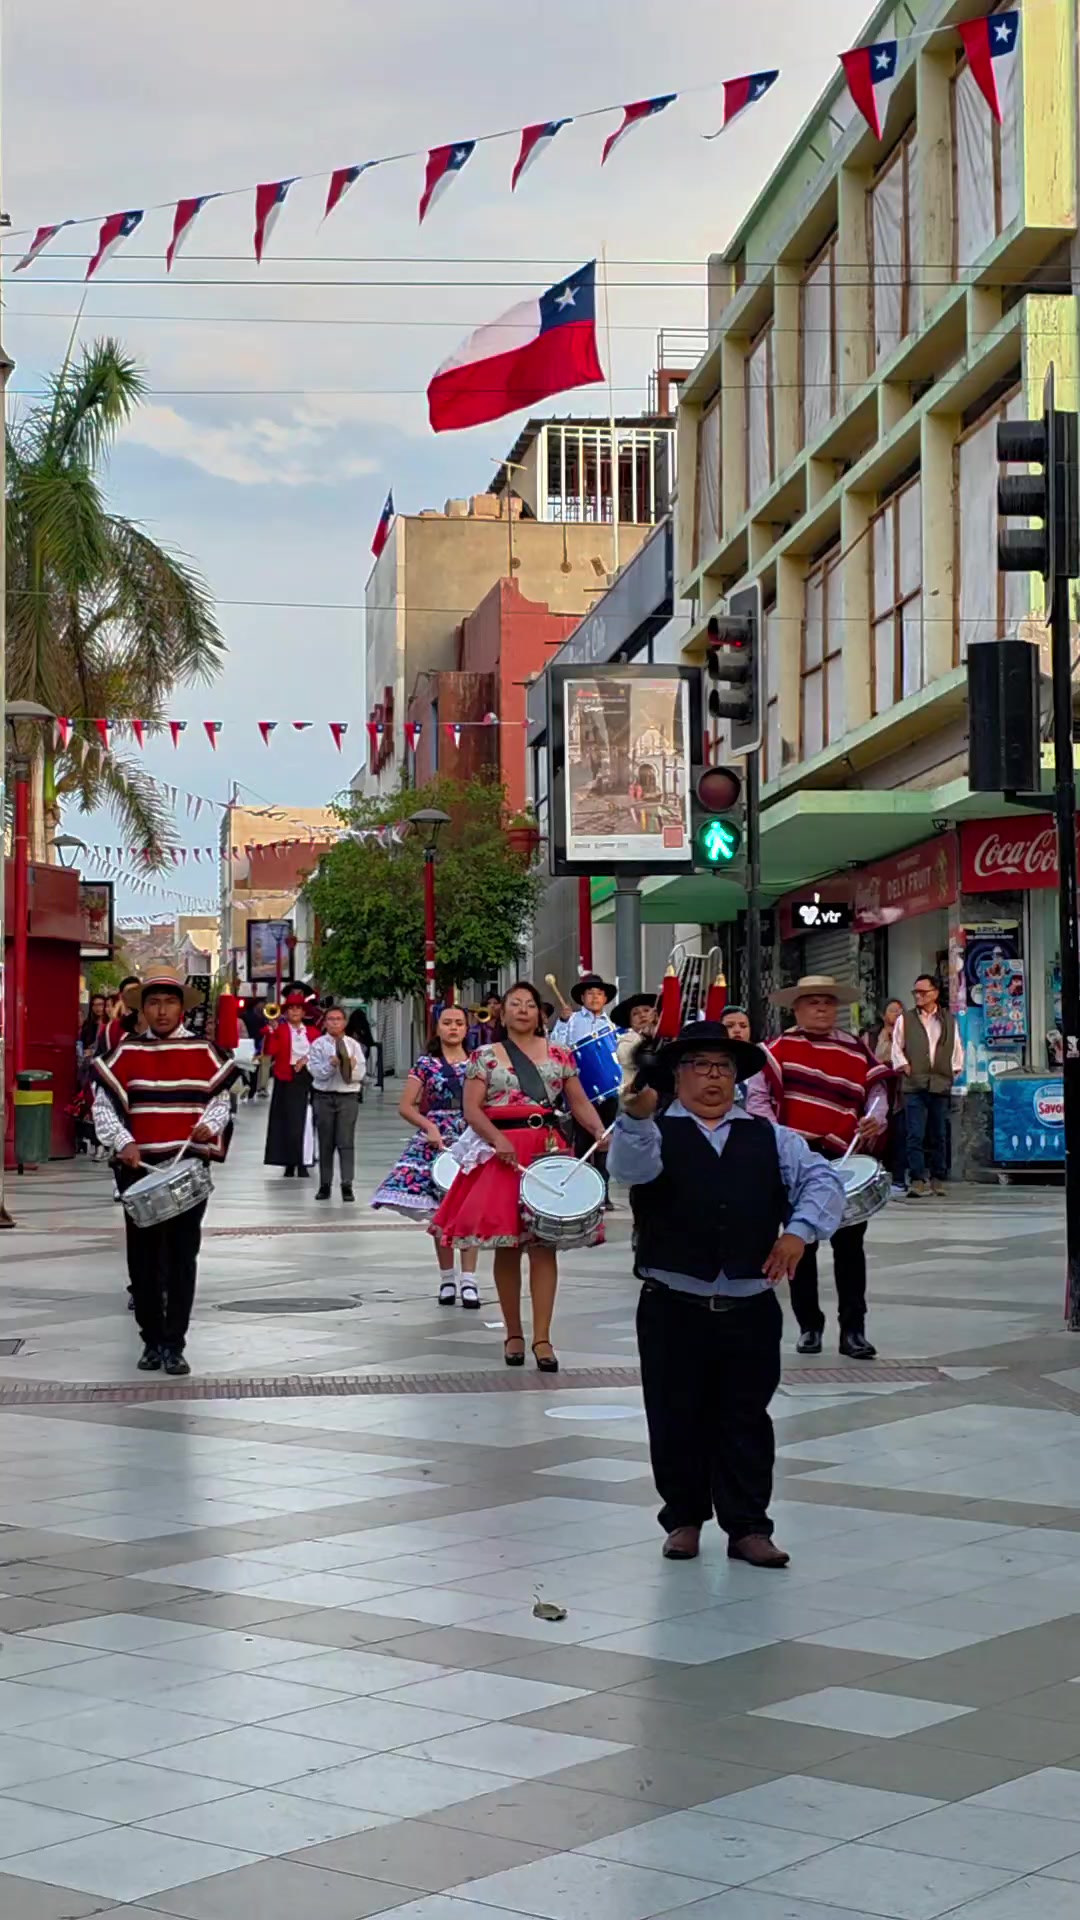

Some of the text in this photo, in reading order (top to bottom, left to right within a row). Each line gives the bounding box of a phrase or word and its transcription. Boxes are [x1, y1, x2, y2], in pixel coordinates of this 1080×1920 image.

[887, 876, 906, 900] DELY
[907, 866, 932, 894] FRUIT
[821, 909, 842, 923] vtr
